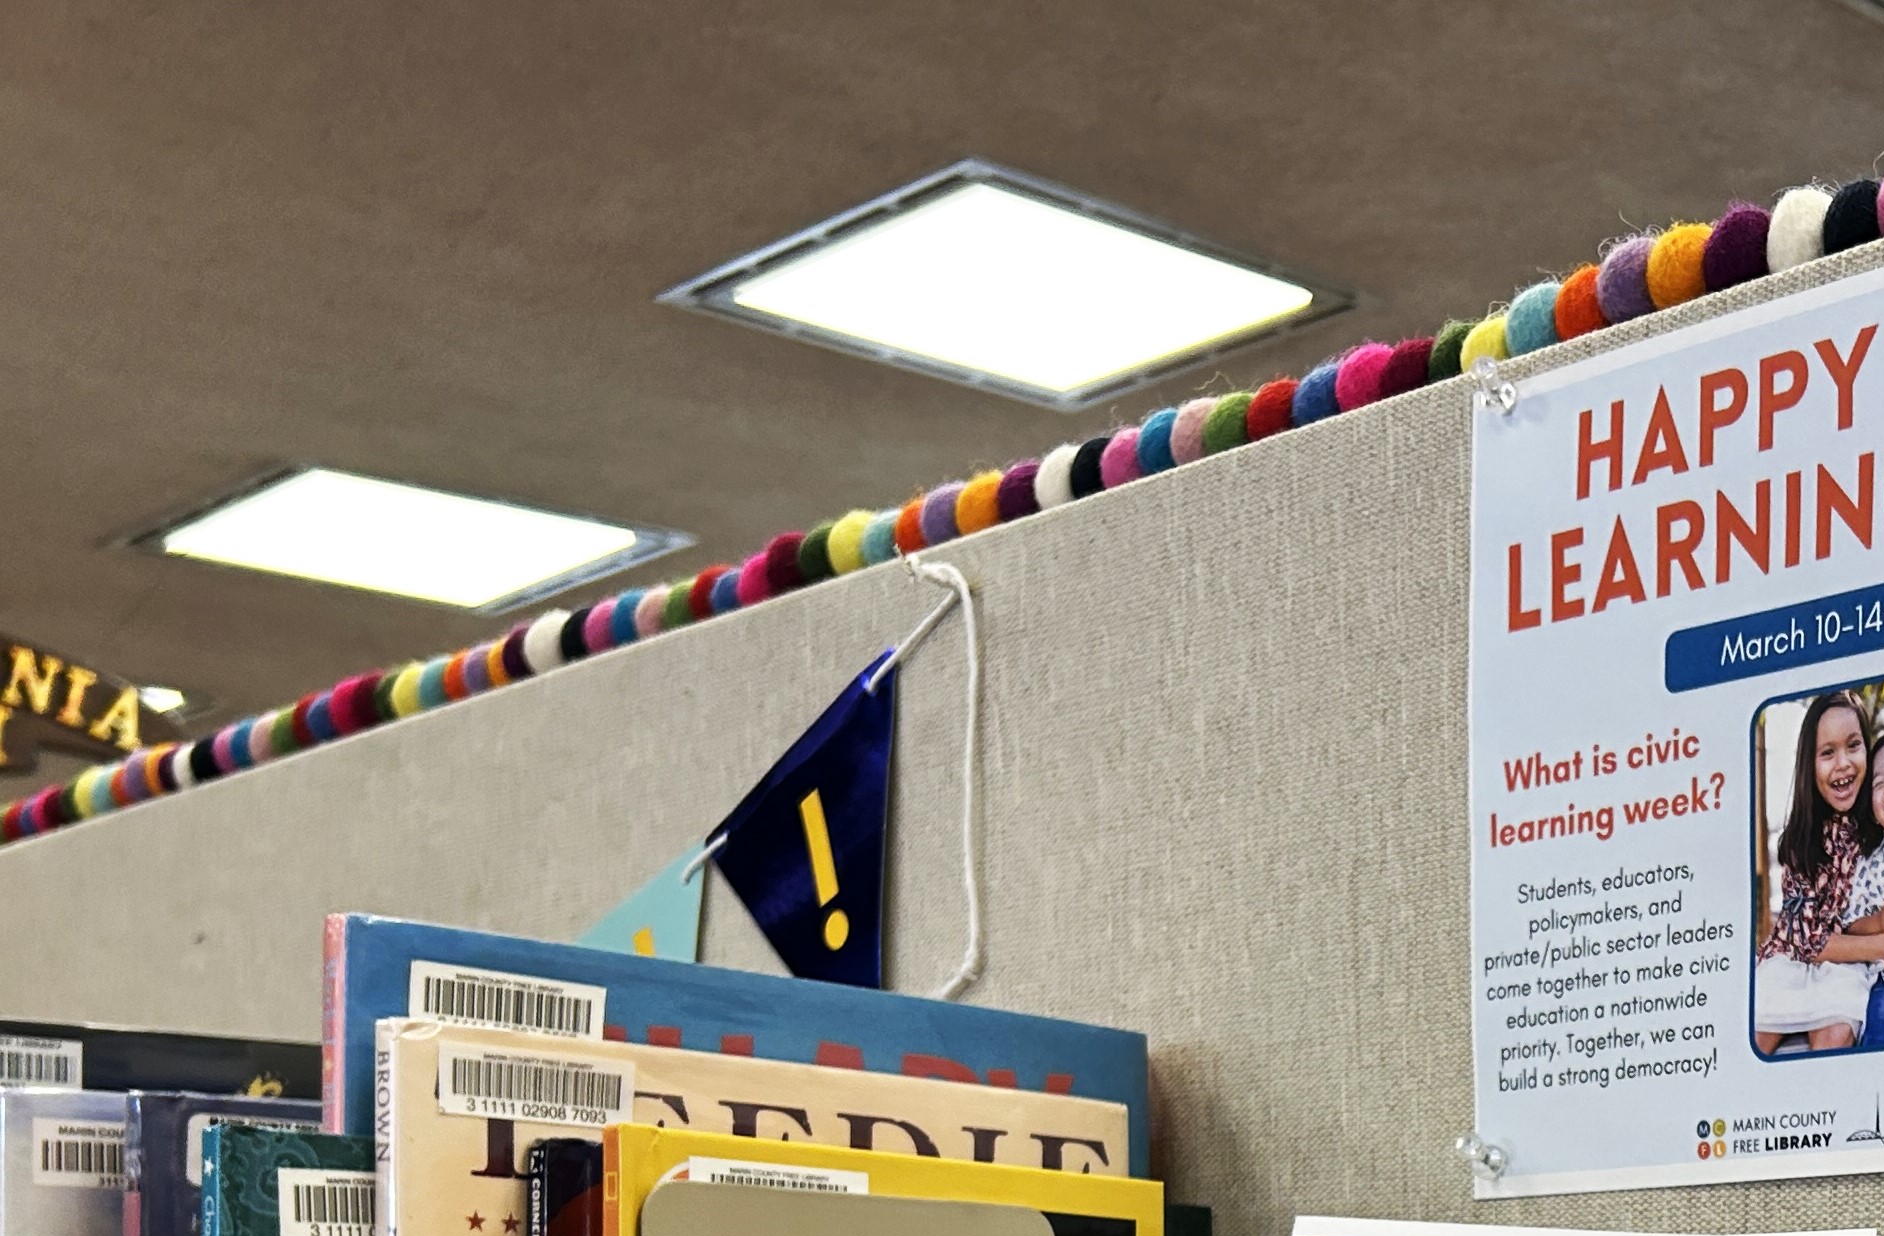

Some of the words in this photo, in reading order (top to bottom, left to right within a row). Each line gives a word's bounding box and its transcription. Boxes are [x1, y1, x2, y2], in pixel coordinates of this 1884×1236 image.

[1577, 323, 1880, 500] HAPPY
[1720, 624, 1806, 669] March
[1504, 750, 1582, 792] What
[1592, 744, 1617, 776] is
[1628, 728, 1700, 770] civic
[1491, 803, 1613, 847] learning
[1624, 772, 1726, 825] week?
[800, 788, 849, 951] !
[1518, 873, 1596, 904] Students,
[1602, 864, 1695, 896] educators,
[1529, 901, 1643, 939] policymakers,
[1649, 891, 1682, 916] and
[1485, 941, 1601, 976] private/public
[1607, 933, 1660, 955] sector
[1666, 921, 1733, 949] leaders
[1486, 980, 1531, 1001] come
[1537, 971, 1608, 998] together
[1614, 968, 1630, 986] to
[1636, 958, 1682, 982] make
[1689, 955, 1730, 976] civic
[1506, 1005, 1589, 1030] education
[1594, 1003, 1605, 1019] a
[1611, 988, 1707, 1017] nationwide
[1501, 1037, 1561, 1063] priority.
[1566, 1026, 1645, 1057] Together,
[1650, 1027, 1675, 1044] we
[1682, 1023, 1715, 1041] can
[1499, 1067, 1537, 1092] build
[1543, 1072, 1553, 1087] a
[1558, 1064, 1609, 1088] strong
[1615, 1048, 1717, 1082] democracy!
[377, 1051, 391, 1162] BROWN
[1733, 1117, 1775, 1133] MARIN
[1780, 1111, 1837, 1129] COUNTY
[1733, 1139, 1761, 1154] FREE
[1765, 1133, 1832, 1152] LIBRARY
